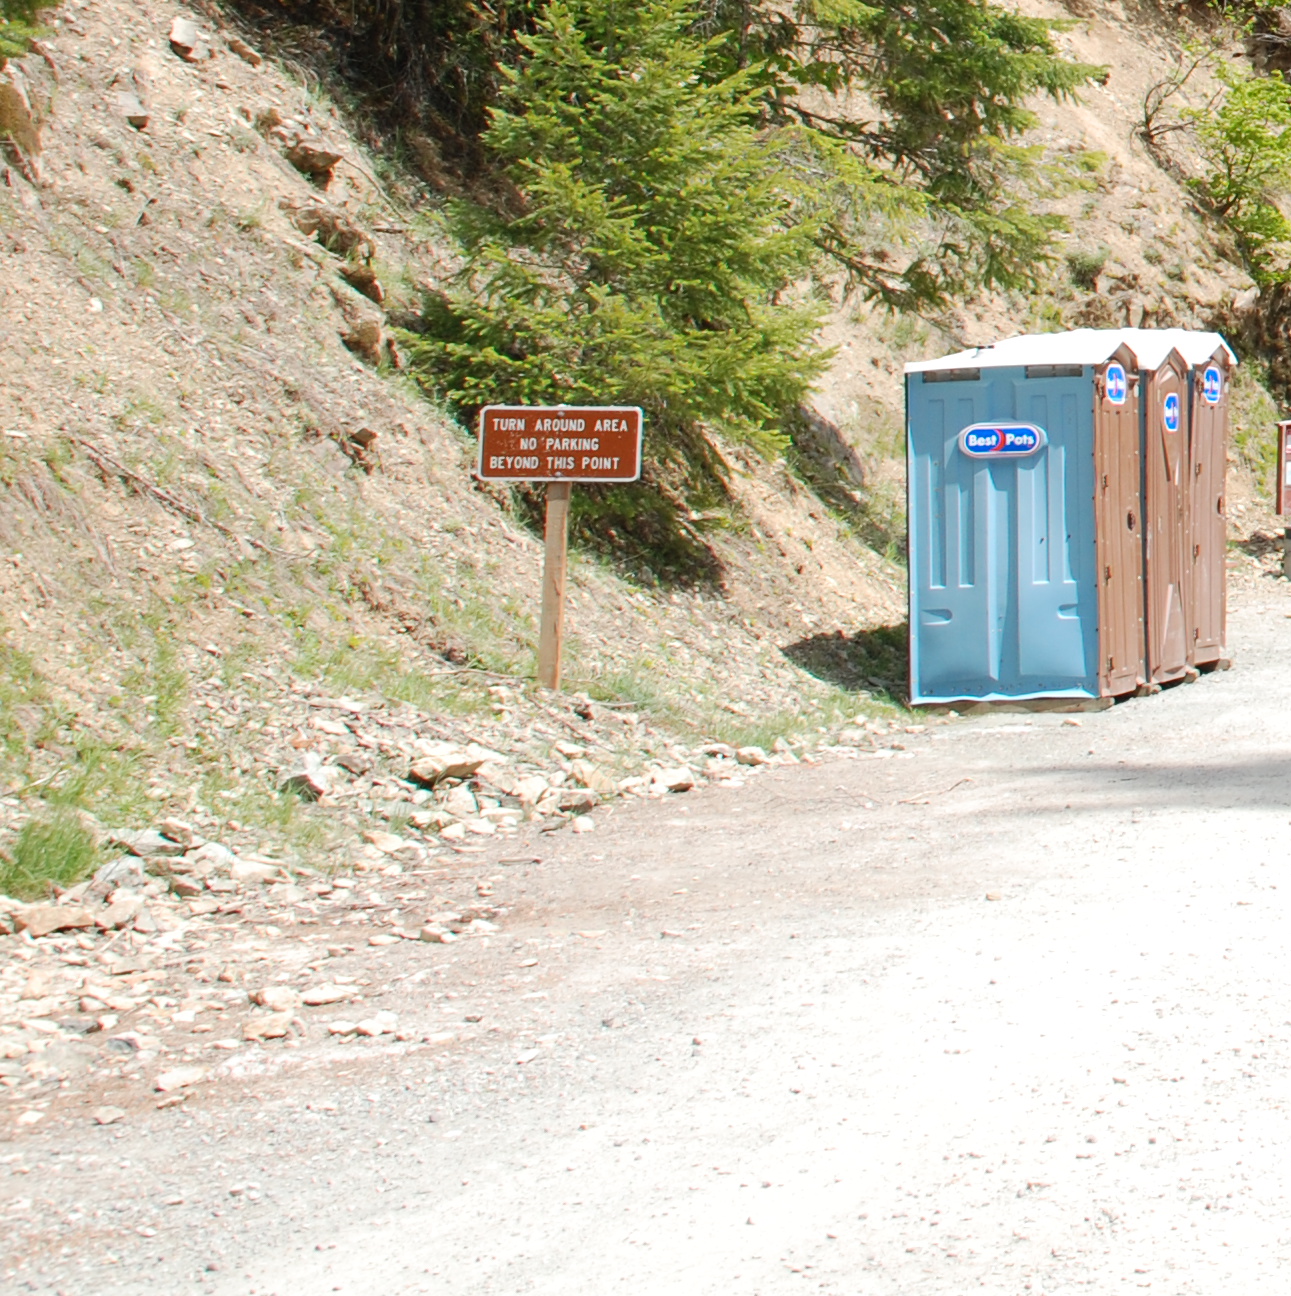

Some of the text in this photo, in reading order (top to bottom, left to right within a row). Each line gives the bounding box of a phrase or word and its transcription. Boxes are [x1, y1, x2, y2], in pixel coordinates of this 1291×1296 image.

[492, 418, 628, 432] TURN AROUND AREA
[520, 438, 599, 451] NO PARKING
[968, 433, 1034, 446] Best Pots
[489, 456, 620, 470] BEYOND THIS POINT
